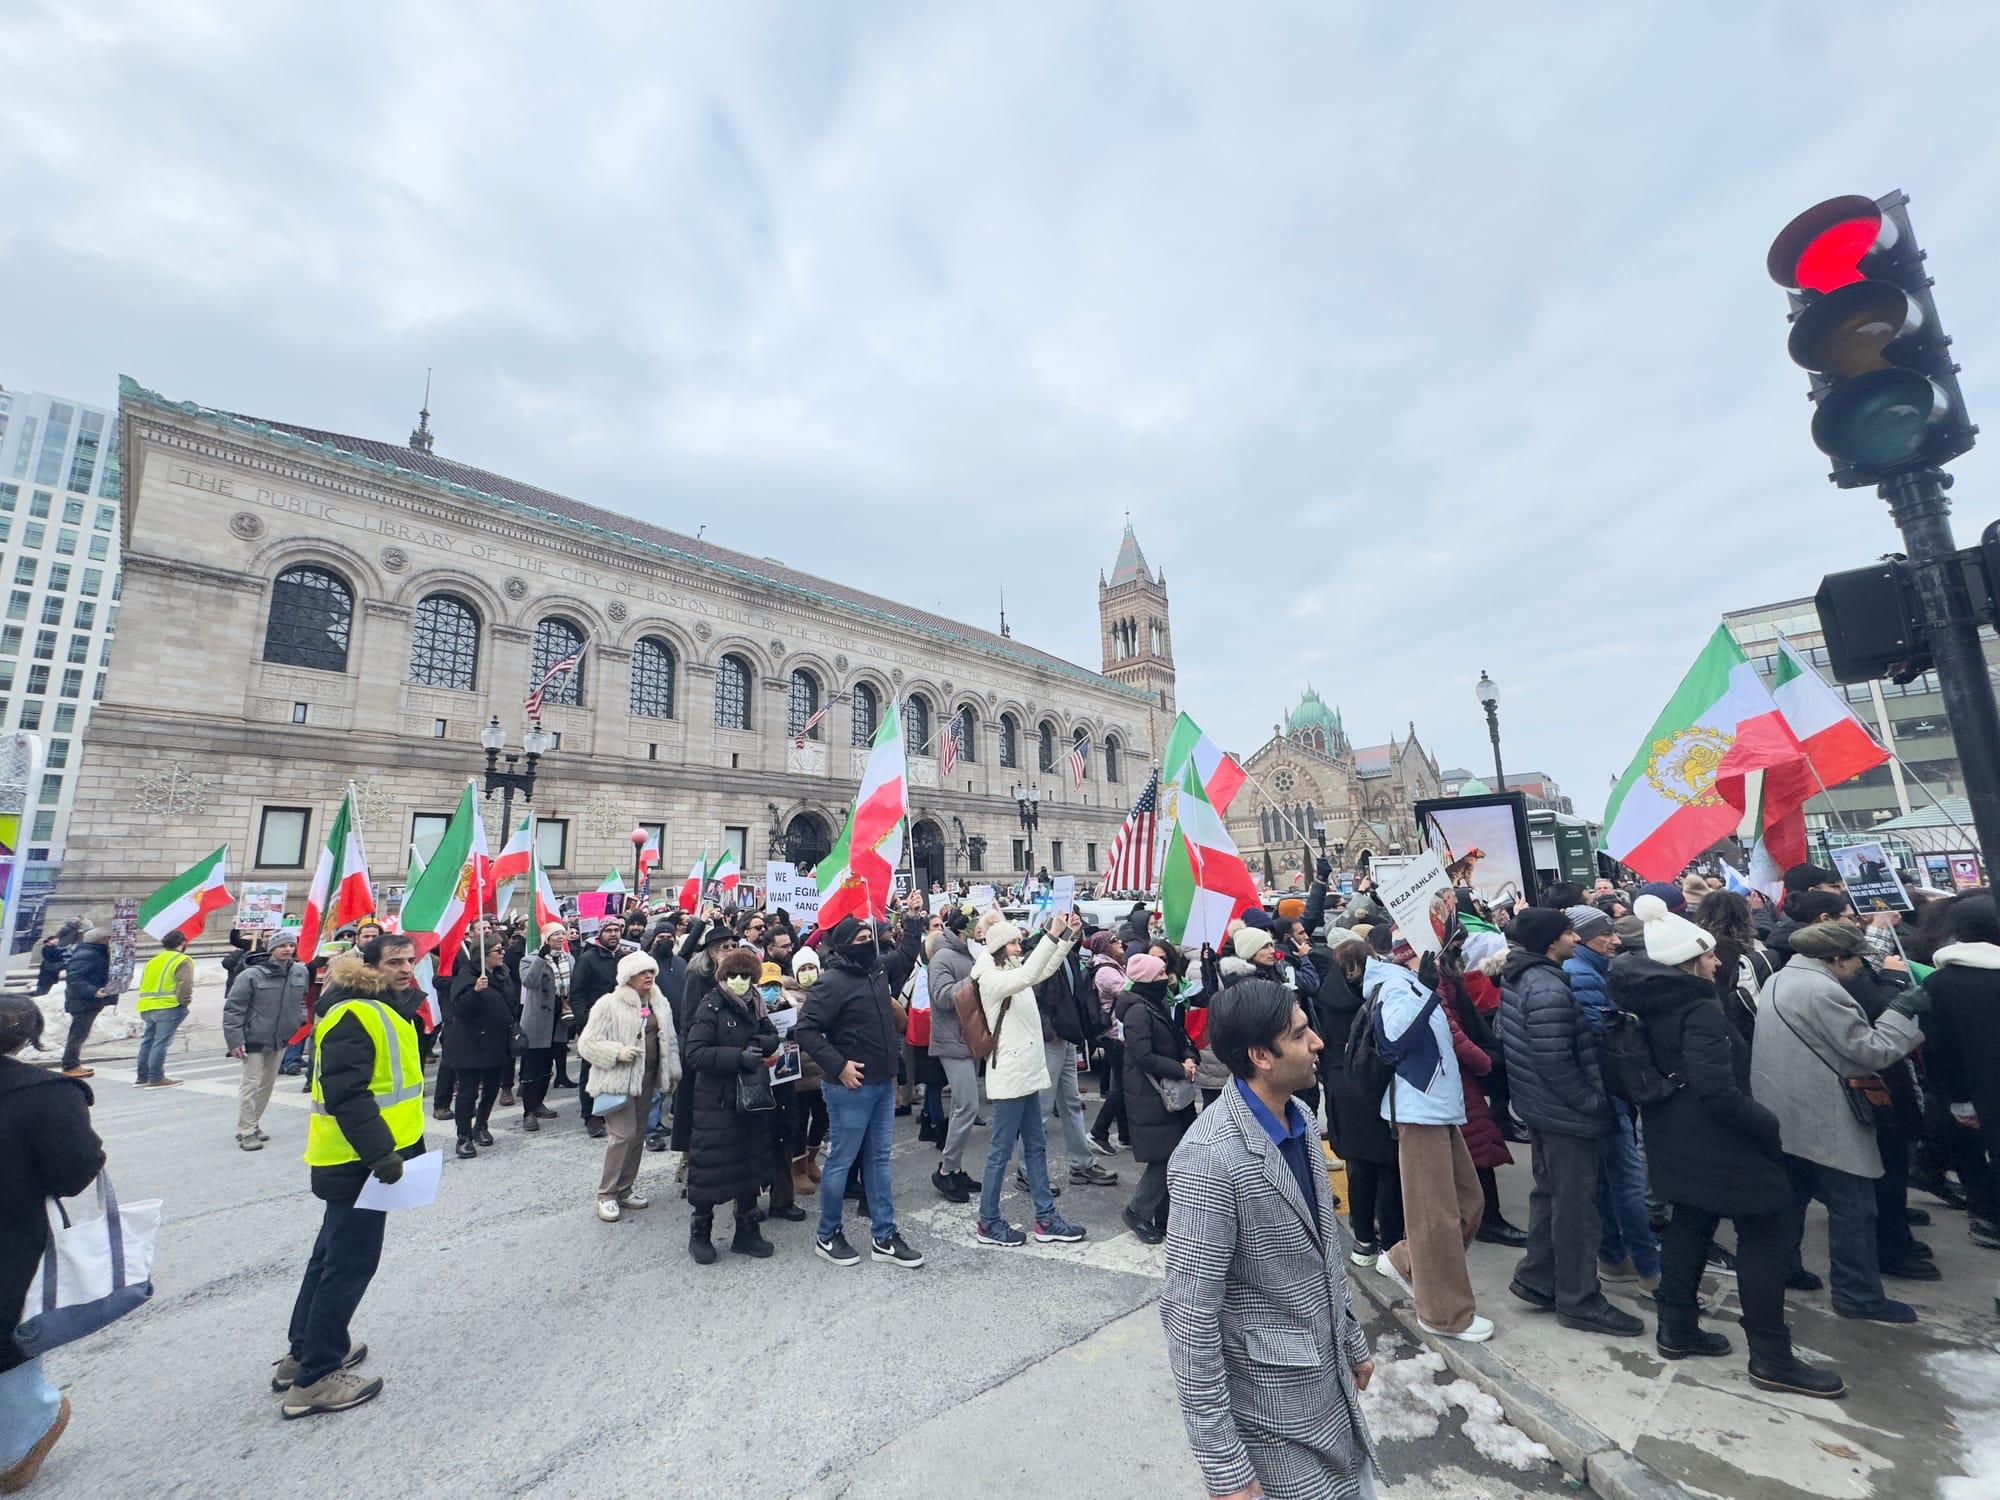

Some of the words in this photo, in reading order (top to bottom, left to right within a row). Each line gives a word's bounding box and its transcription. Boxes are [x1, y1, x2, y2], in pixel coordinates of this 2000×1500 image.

[179, 468, 233, 498] THE
[256, 488, 340, 522] PUBLIC
[363, 515, 457, 550] LIBRARY
[471, 543, 498, 561] OF
[514, 554, 549, 574] THE
[560, 567, 601, 588] CITY
[615, 580, 637, 596] OF
[646, 589, 709, 616] BOSTON
[717, 606, 755, 627] BUILT
[761, 617, 778, 631] BY
[787, 624, 811, 640] THE
[818, 632, 857, 651] PEOPLE
[866, 644, 887, 659] AND
[775, 872, 787, 882] WE
[795, 887, 821, 898] EGIM
[1390, 891, 1411, 908] REZA
[1410, 867, 1440, 894] PAHLAVI
[770, 893, 792, 902] WANT
[795, 901, 819, 912] HANG
